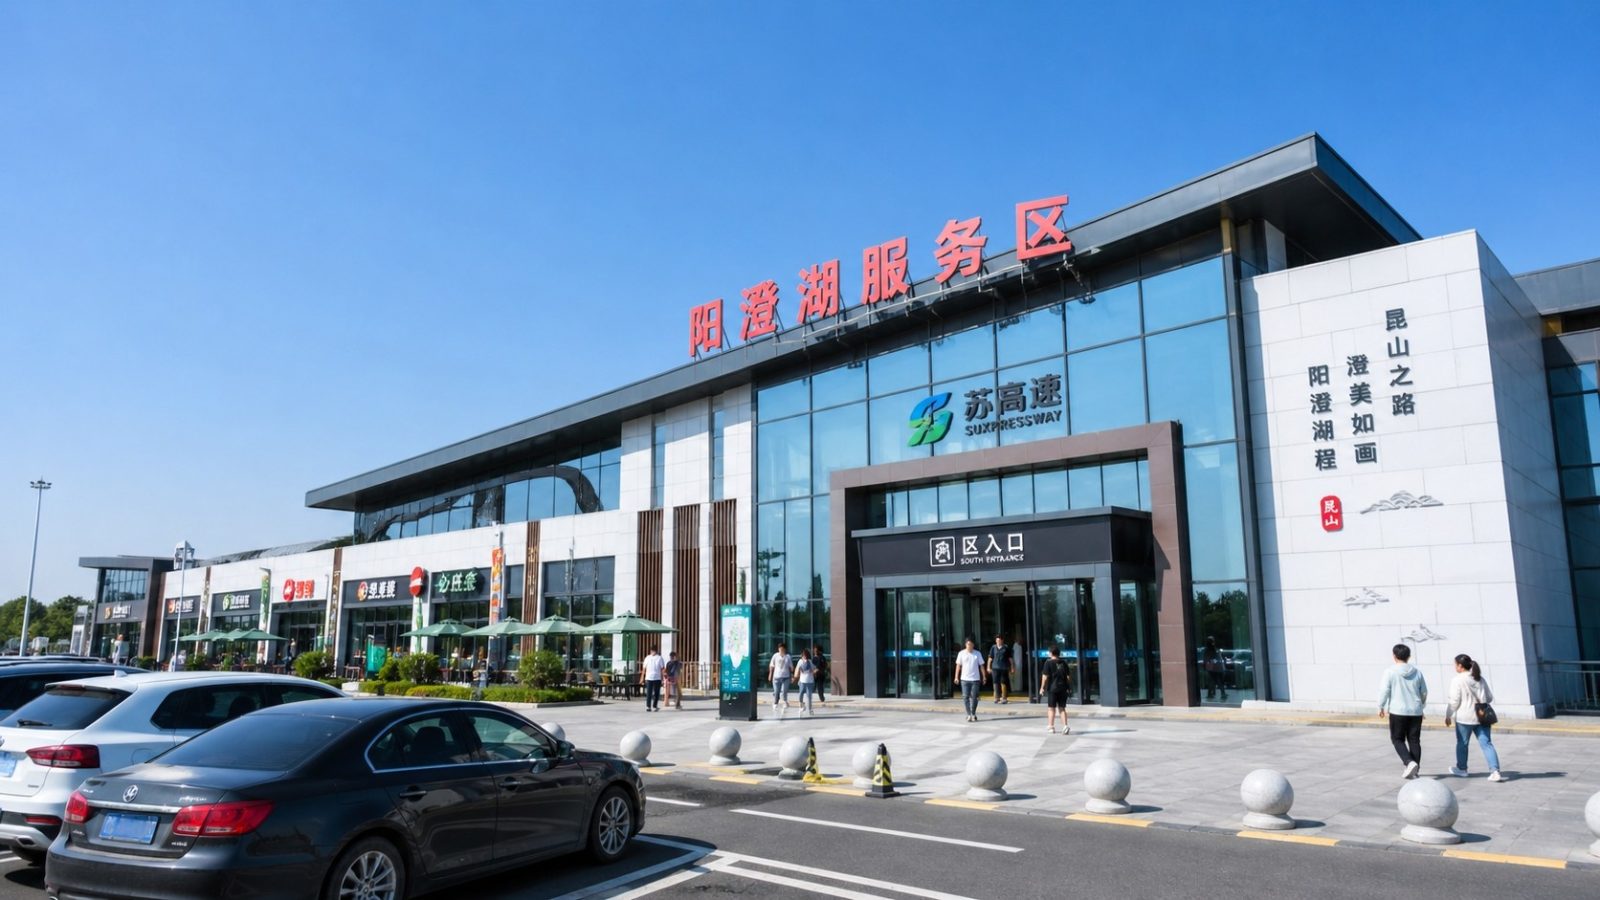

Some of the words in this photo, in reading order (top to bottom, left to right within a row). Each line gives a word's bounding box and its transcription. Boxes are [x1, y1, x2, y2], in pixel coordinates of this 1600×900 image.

[688, 194, 1072, 357] 阳澄湖服务区
[964, 373, 1062, 422] 苏高速
[1385, 307, 1416, 416] 昆山之路
[965, 410, 1063, 437] SUXPRESSWAY
[1308, 364, 1337, 472] 阳澄湖程
[1346, 353, 1378, 464] 澄美如画
[960, 557, 984, 565] SOUTH
[962, 532, 1024, 555] 区入口
